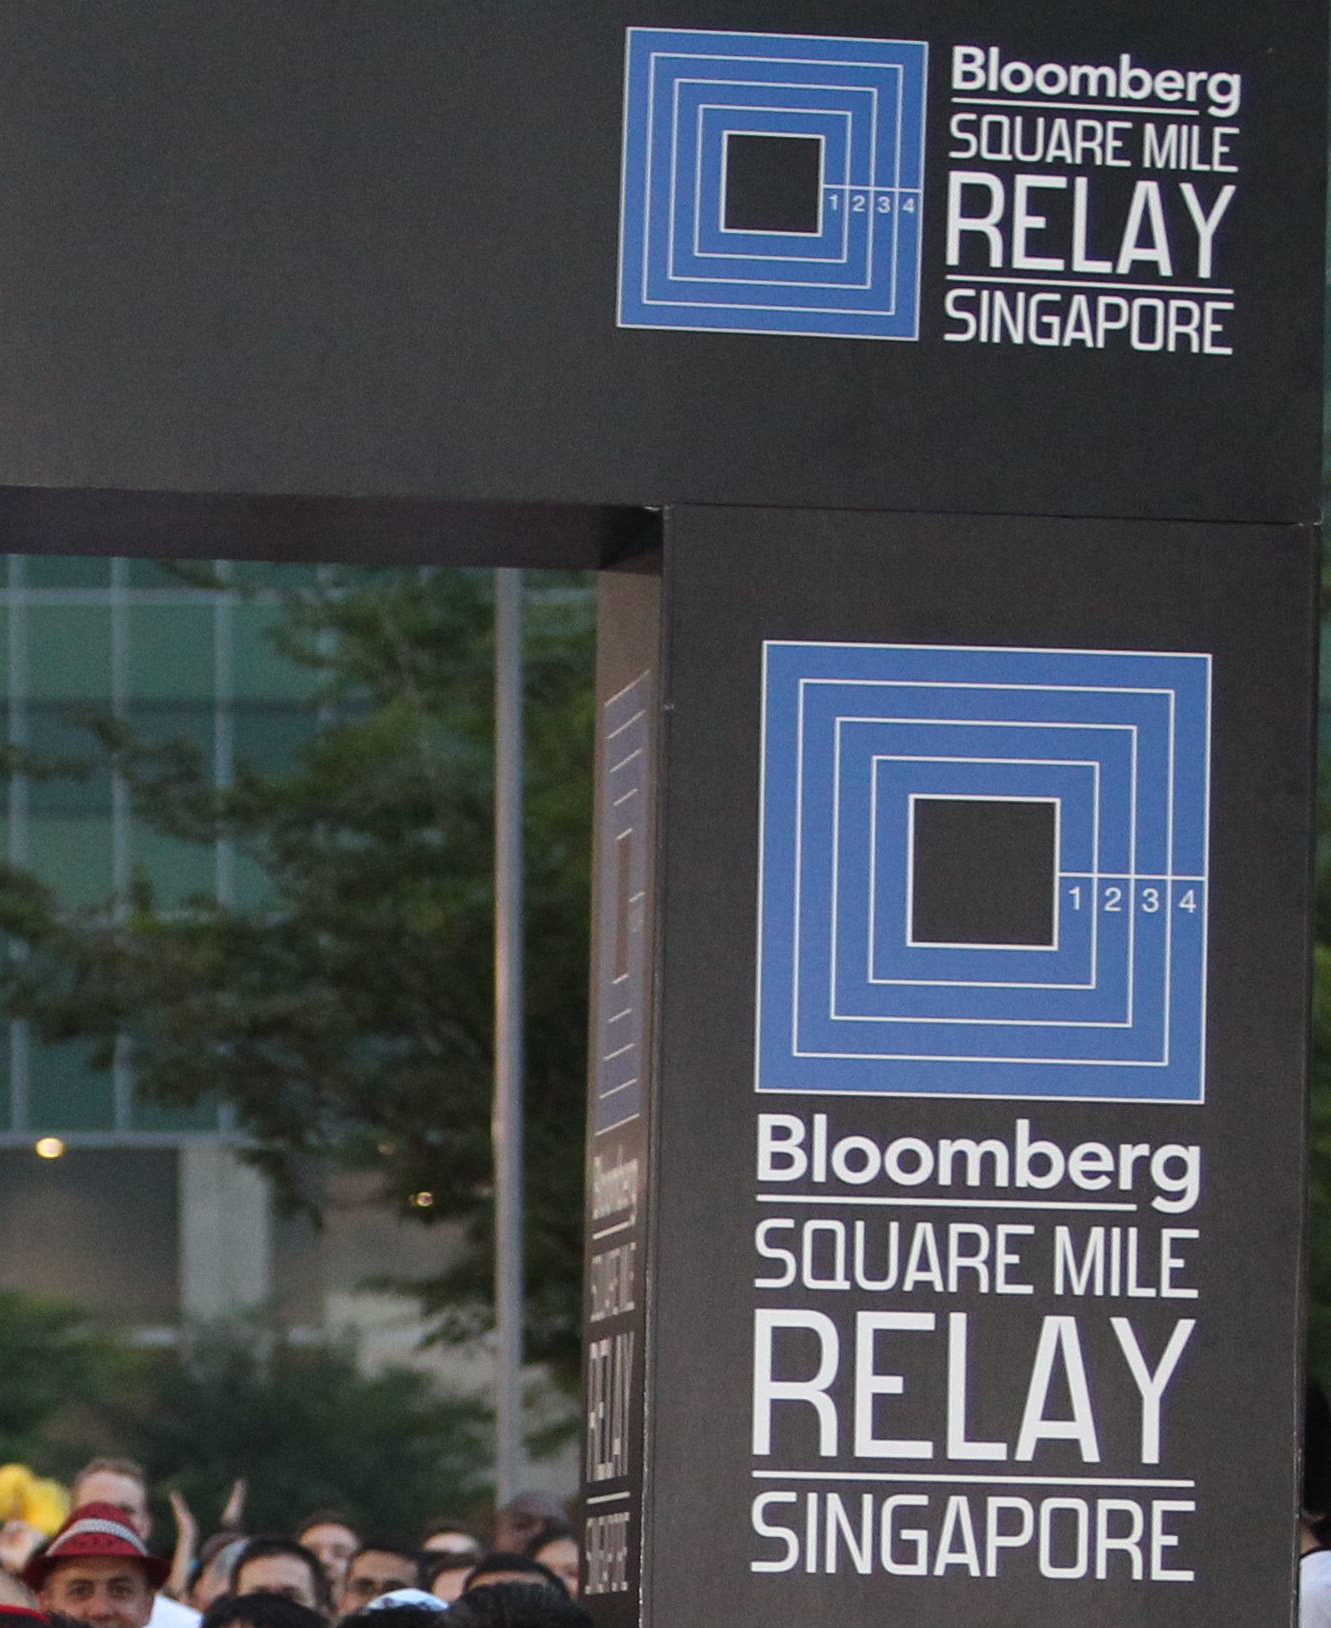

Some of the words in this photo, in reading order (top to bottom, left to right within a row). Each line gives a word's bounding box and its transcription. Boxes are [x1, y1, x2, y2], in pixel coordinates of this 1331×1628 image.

[951, 45, 1242, 118] Bloomberg
[949, 113, 1133, 167] SQUARE
[1143, 123, 1240, 173] MILE
[829, 194, 839, 212] 1
[852, 195, 866, 214] 2
[877, 197, 891, 215] 3
[901, 198, 916, 216] 4
[944, 171, 1237, 279] RELAY
[943, 288, 1235, 356] SINGAPORE
[1068, 887, 1082, 911] 1
[1105, 887, 1123, 913] 2
[1142, 888, 1159, 914] 3
[1179, 889, 1197, 914] 4
[757, 1113, 1202, 1214] Bloomberg
[753, 1218, 1035, 1295] SQUARE
[1053, 1225, 1200, 1299] MILE
[751, 1308, 1197, 1465] RELAY
[750, 1491, 1196, 1583] SINGAPORE
